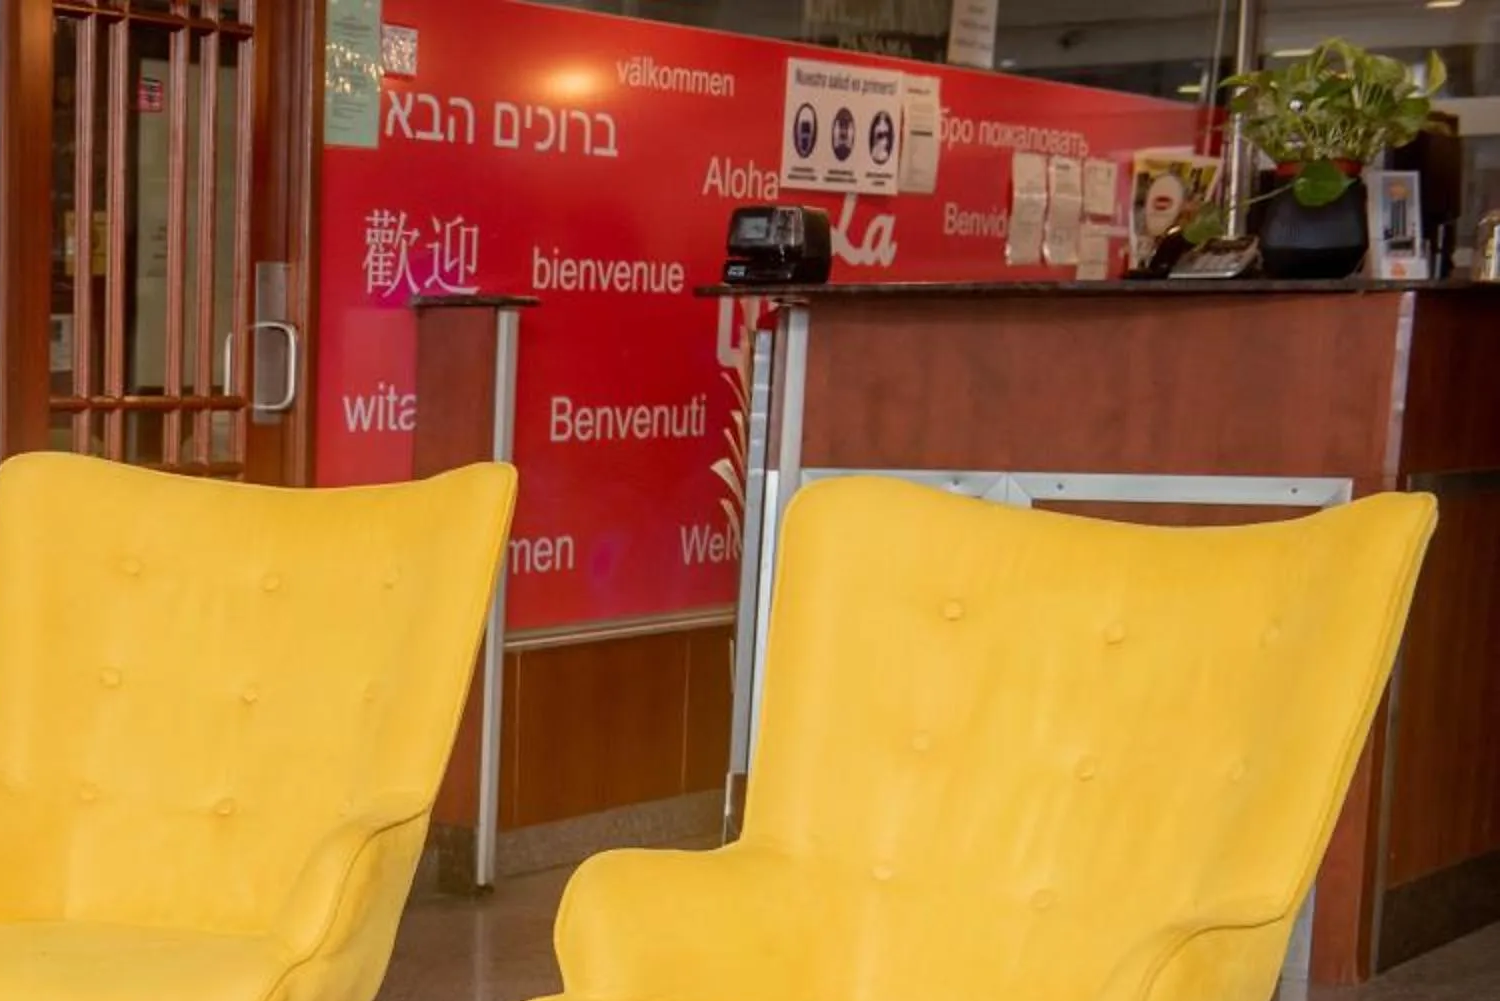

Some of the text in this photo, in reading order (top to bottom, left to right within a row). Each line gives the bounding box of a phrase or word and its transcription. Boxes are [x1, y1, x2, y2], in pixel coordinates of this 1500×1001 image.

[615, 56, 736, 97] välkommen
[493, 101, 619, 157] ברוכים
[703, 157, 779, 201] Aloha
[362, 208, 481, 298] 歡迎
[532, 246, 684, 293] bienvenue
[550, 394, 707, 442] Benvenuti
